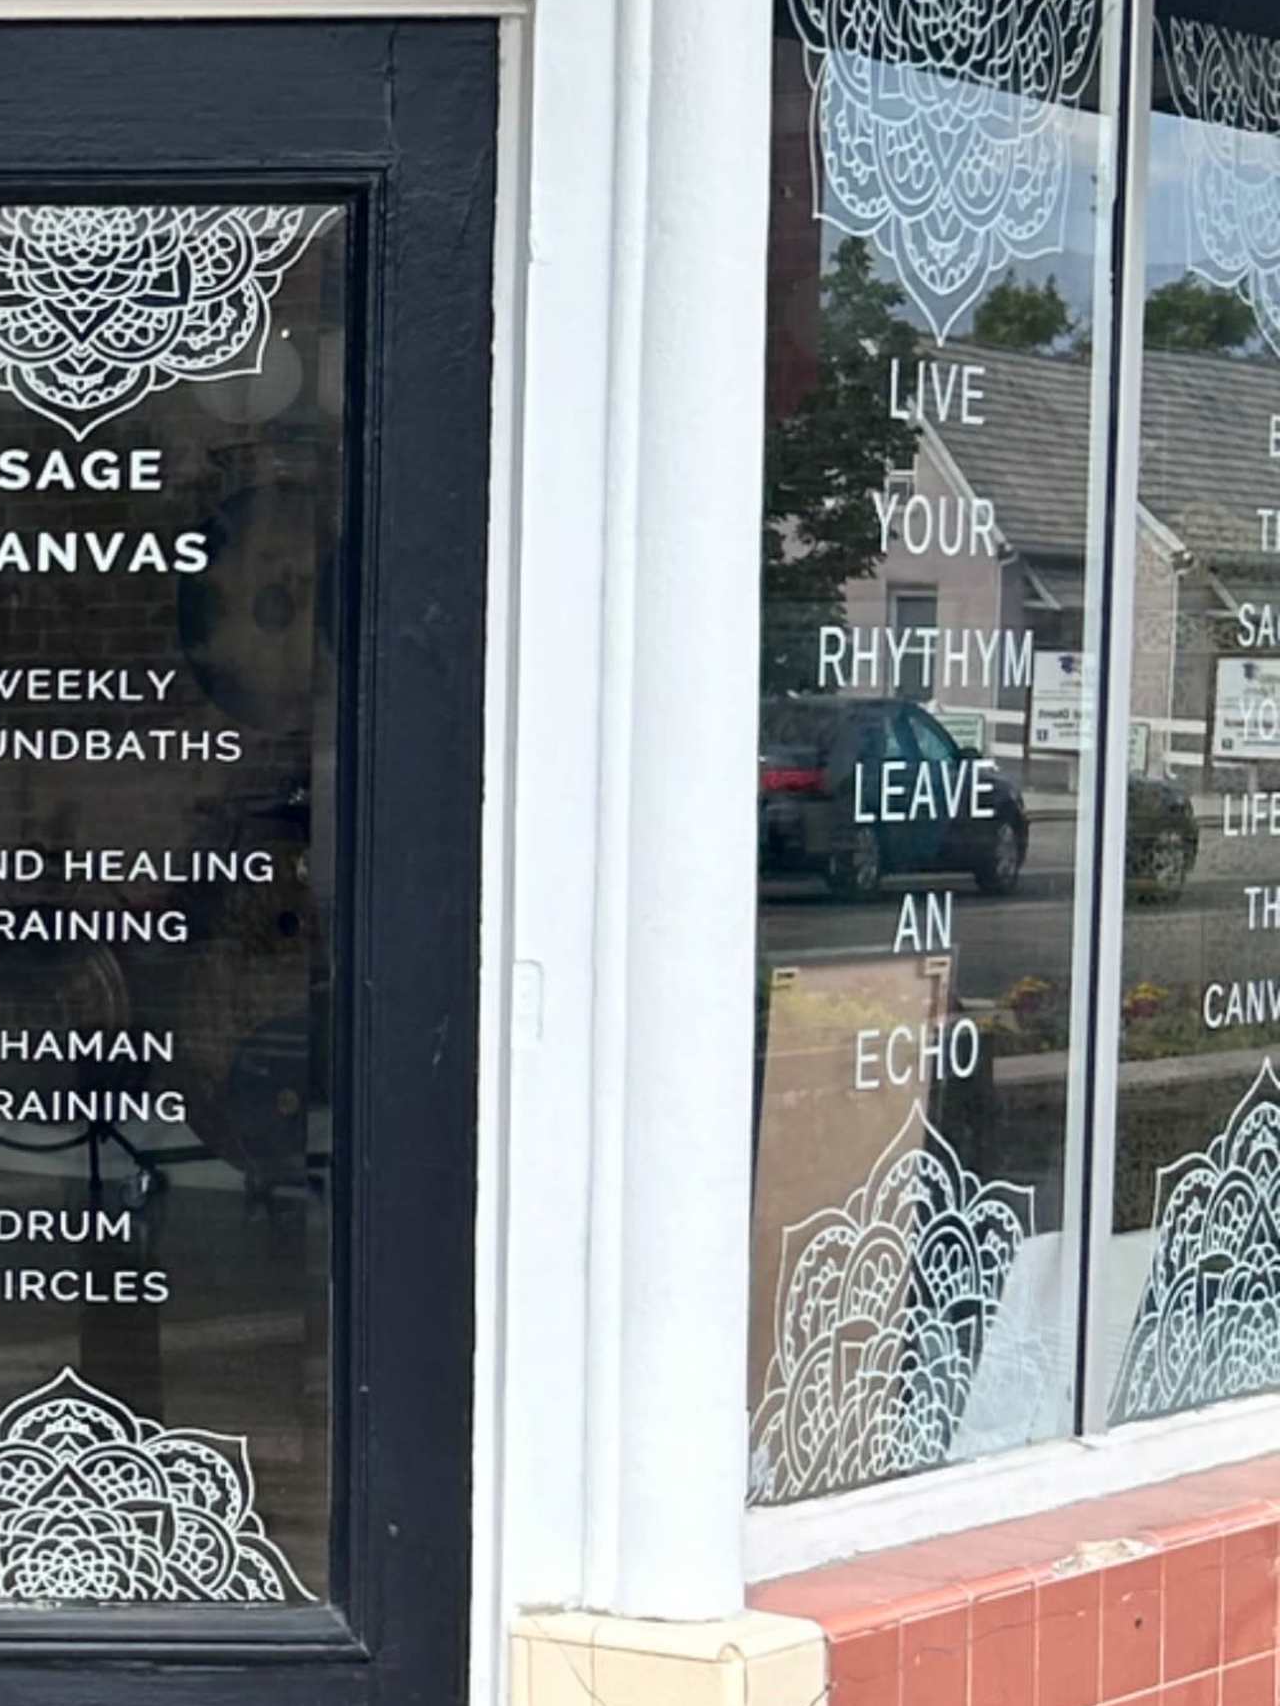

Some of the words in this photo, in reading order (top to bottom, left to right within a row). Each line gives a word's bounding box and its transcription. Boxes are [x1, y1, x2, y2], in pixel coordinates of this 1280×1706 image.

[889, 358, 986, 426] LIVE
[869, 492, 995, 557] YOUR
[818, 625, 1033, 688] RHYTHYM
[854, 759, 996, 823] LEAVE
[64, 849, 274, 883] HEALING
[893, 890, 953, 953] AN
[855, 1014, 979, 1089] ECHO
